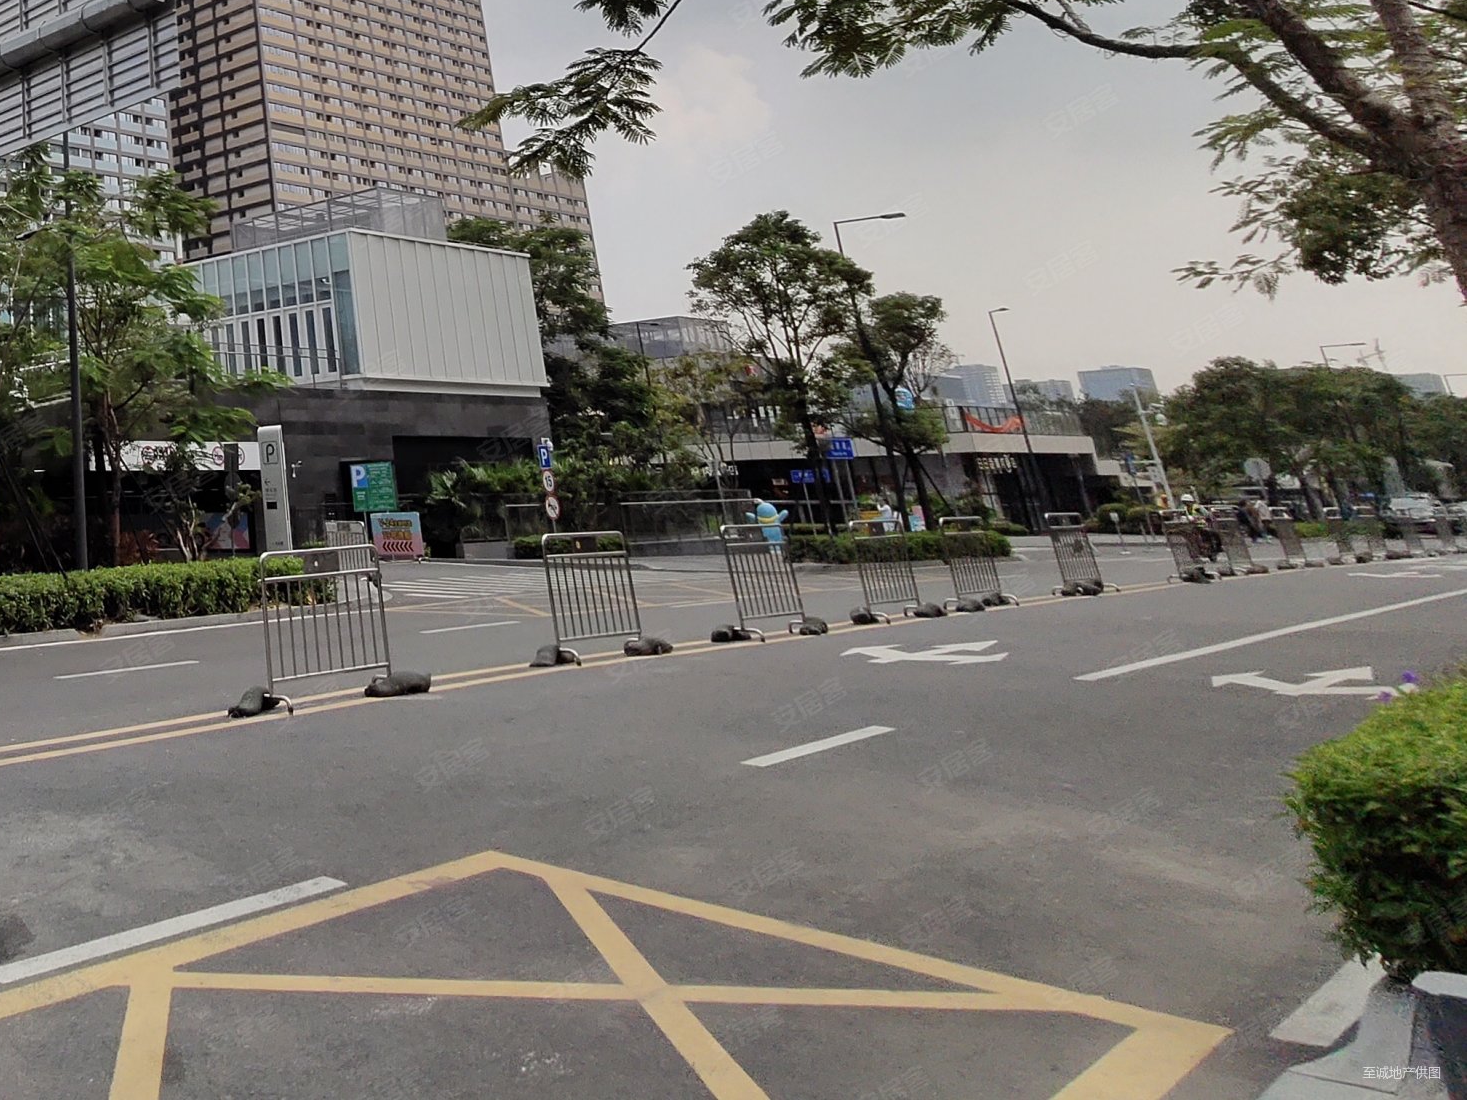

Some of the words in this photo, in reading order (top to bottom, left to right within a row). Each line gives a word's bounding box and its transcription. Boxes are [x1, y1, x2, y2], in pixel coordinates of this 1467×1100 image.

[266, 443, 275, 462] P
[540, 448, 548, 466] P
[350, 465, 366, 488] P
